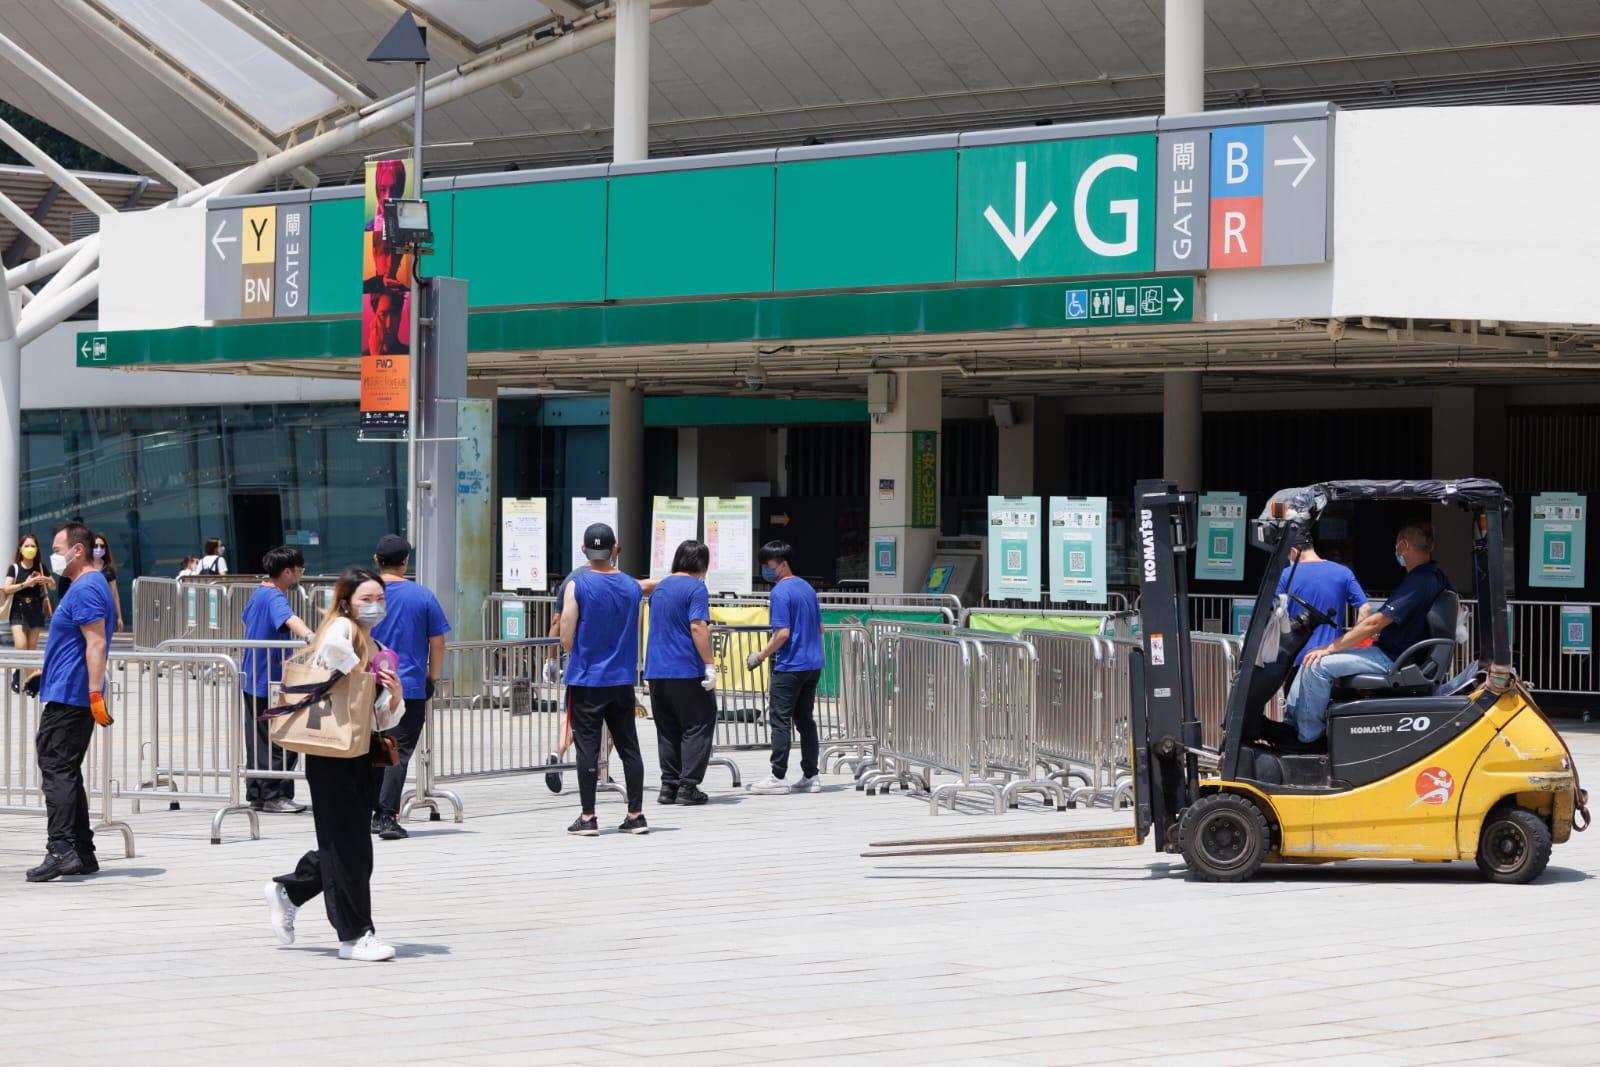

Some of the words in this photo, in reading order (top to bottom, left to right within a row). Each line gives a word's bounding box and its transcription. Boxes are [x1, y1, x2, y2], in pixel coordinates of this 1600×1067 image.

[1173, 142, 1194, 171] 閘
[1226, 142, 1249, 184] B
[286, 213, 300, 237] 閘
[1073, 154, 1139, 257] G
[1173, 178, 1193, 260] GATE
[250, 218, 268, 251] Y
[1224, 212, 1248, 254] R
[244, 278, 270, 303] BN
[285, 243, 300, 308] GATE
[1139, 509, 1157, 582] KOMATSU
[1350, 724, 1393, 735] KOMATSU
[1396, 716, 1431, 732] 20
